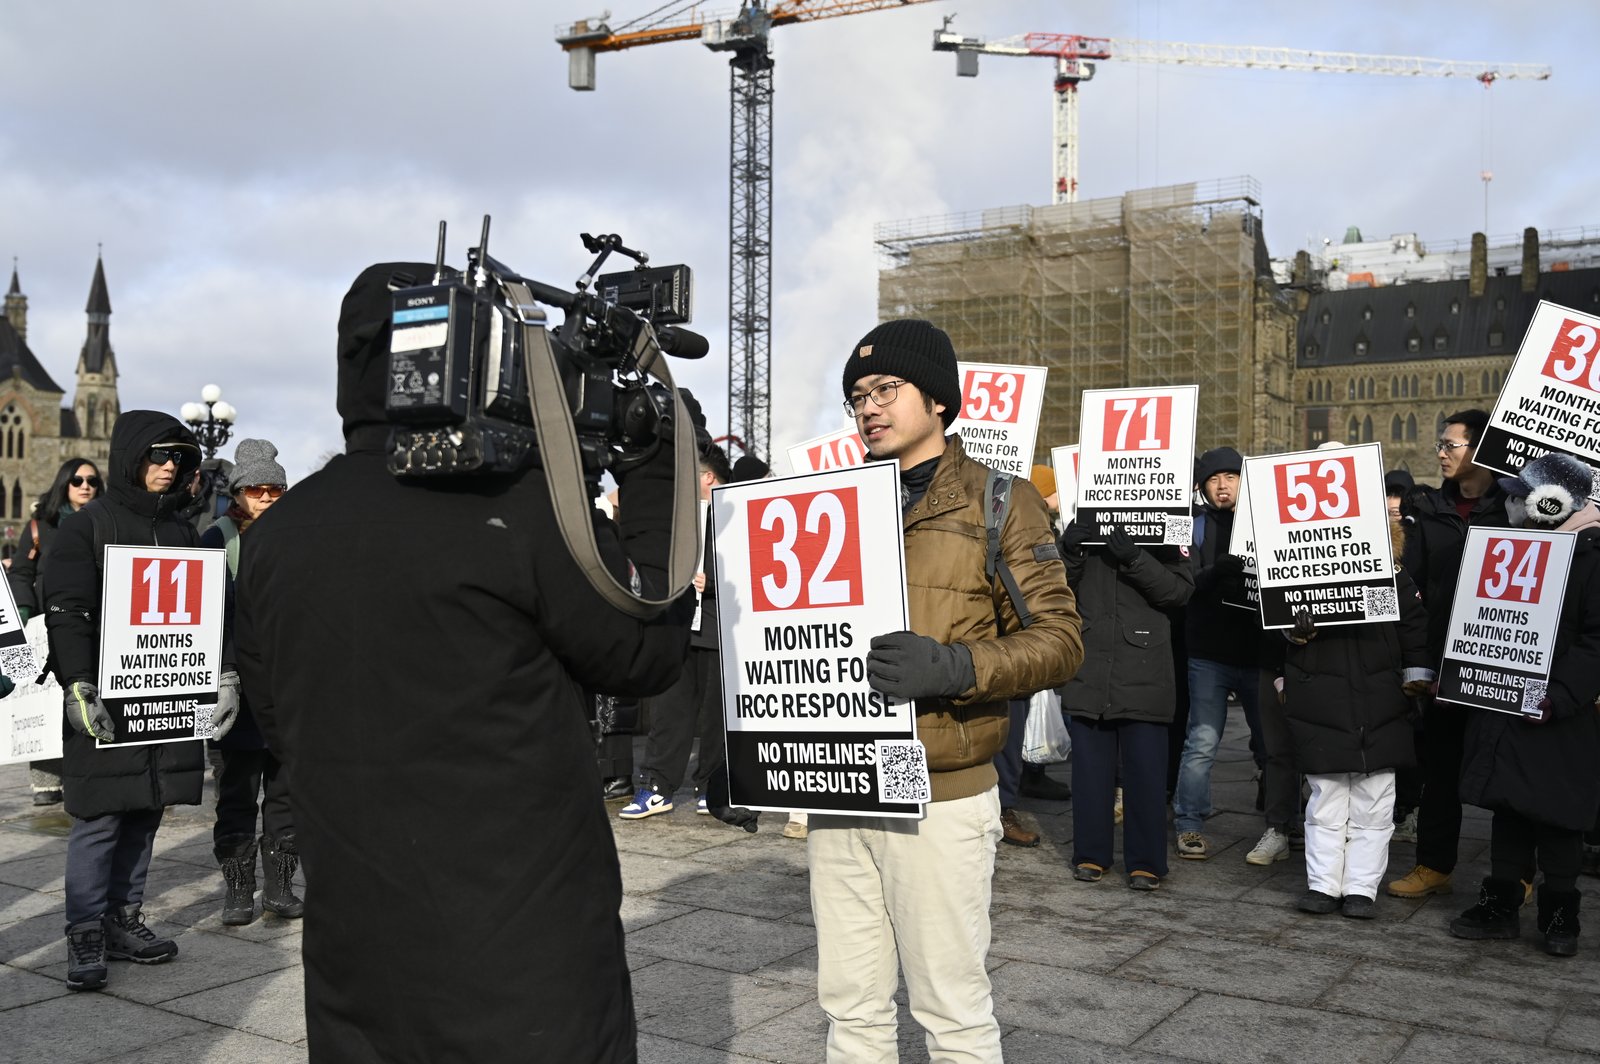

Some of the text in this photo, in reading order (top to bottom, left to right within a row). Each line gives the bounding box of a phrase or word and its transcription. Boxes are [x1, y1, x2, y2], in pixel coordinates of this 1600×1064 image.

[407, 297, 435, 306] SONY
[965, 372, 1017, 420] 53
[1113, 398, 1161, 450] 71
[1502, 410, 1536, 432] IRCC
[1518, 397, 1582, 432] WAITING
[961, 427, 1008, 440] MONTHS
[964, 442, 1018, 456] ITING FOR
[1506, 438, 1526, 452] NO
[1107, 457, 1161, 469] MONTHS
[1506, 454, 1525, 468] NO
[1094, 472, 1174, 486] WAITING FOR
[1085, 489, 1182, 501] IRCC RESPONSE
[1286, 460, 1350, 522] 53
[1096, 512, 1168, 522] NO TIMELINES
[1124, 525, 1162, 536] ESULTS
[1288, 526, 1352, 544] MONTHS
[760, 492, 850, 609] 32
[1274, 542, 1372, 562] WAITING FOR
[1267, 559, 1383, 580] IRCC RESPONSE
[1484, 539, 1540, 600] 34
[141, 560, 191, 623] 11
[1244, 578, 1258, 589] NO
[1284, 591, 1302, 602] NO
[1312, 600, 1364, 614] RESULTS
[1478, 606, 1529, 626] MONTHS
[136, 633, 193, 649] MONTHS
[764, 622, 853, 651] MONTHS
[1463, 622, 1538, 646] WAITING FOR
[121, 652, 206, 669] WAITING FOR
[1452, 639, 1543, 666] IRCC RESPONSE
[110, 671, 212, 690] IRCC RESPONSE
[745, 656, 866, 685] WAITING FO
[1459, 666, 1525, 689] NO TIMELINES
[1460, 682, 1518, 703] NO RESULTS
[124, 699, 199, 716] NO TIMELINES
[736, 691, 897, 718] IRCC RESPONSE
[128, 715, 194, 733] NO RESULTS
[758, 742, 877, 766] NO TIMELINES
[767, 770, 871, 794] NO RESULTS
